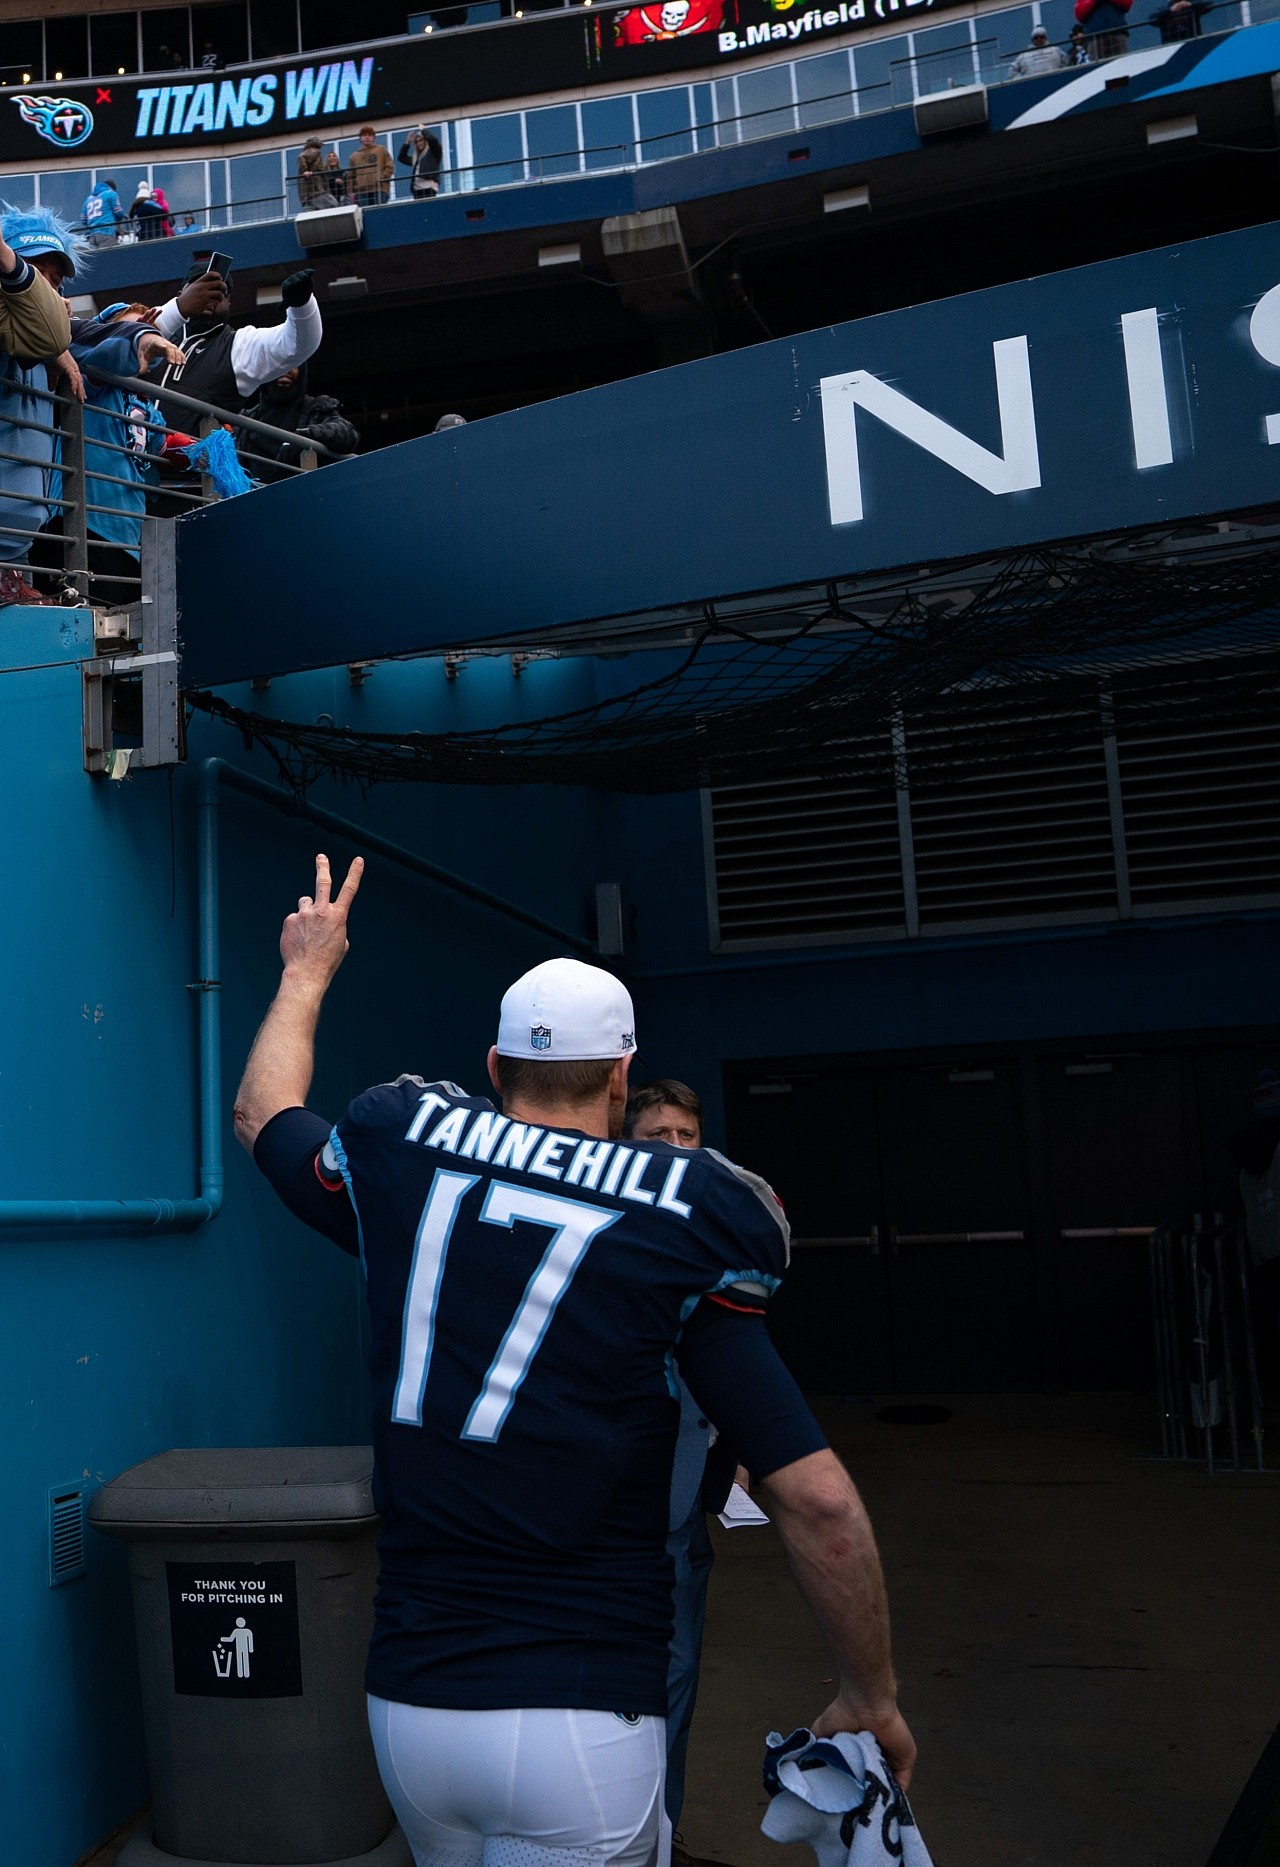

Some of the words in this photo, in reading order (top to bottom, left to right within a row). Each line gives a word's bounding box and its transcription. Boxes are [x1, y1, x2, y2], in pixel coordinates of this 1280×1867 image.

[718, 0, 865, 52] B.Mayfield
[202, 54, 217, 67] 22
[135, 74, 277, 137] TITANS
[285, 57, 374, 119] WIN
[86, 199, 103, 219] 22
[820, 283, 1280, 525] NI
[405, 1092, 692, 1219] TANNEHILL
[391, 1167, 625, 1443] 17
[181, 1593, 205, 1603] FOR
[208, 1594, 266, 1604] PITCHING
[269, 1594, 283, 1603] IN
[194, 1580, 236, 1590] THANK
[239, 1580, 266, 1590] YOU
